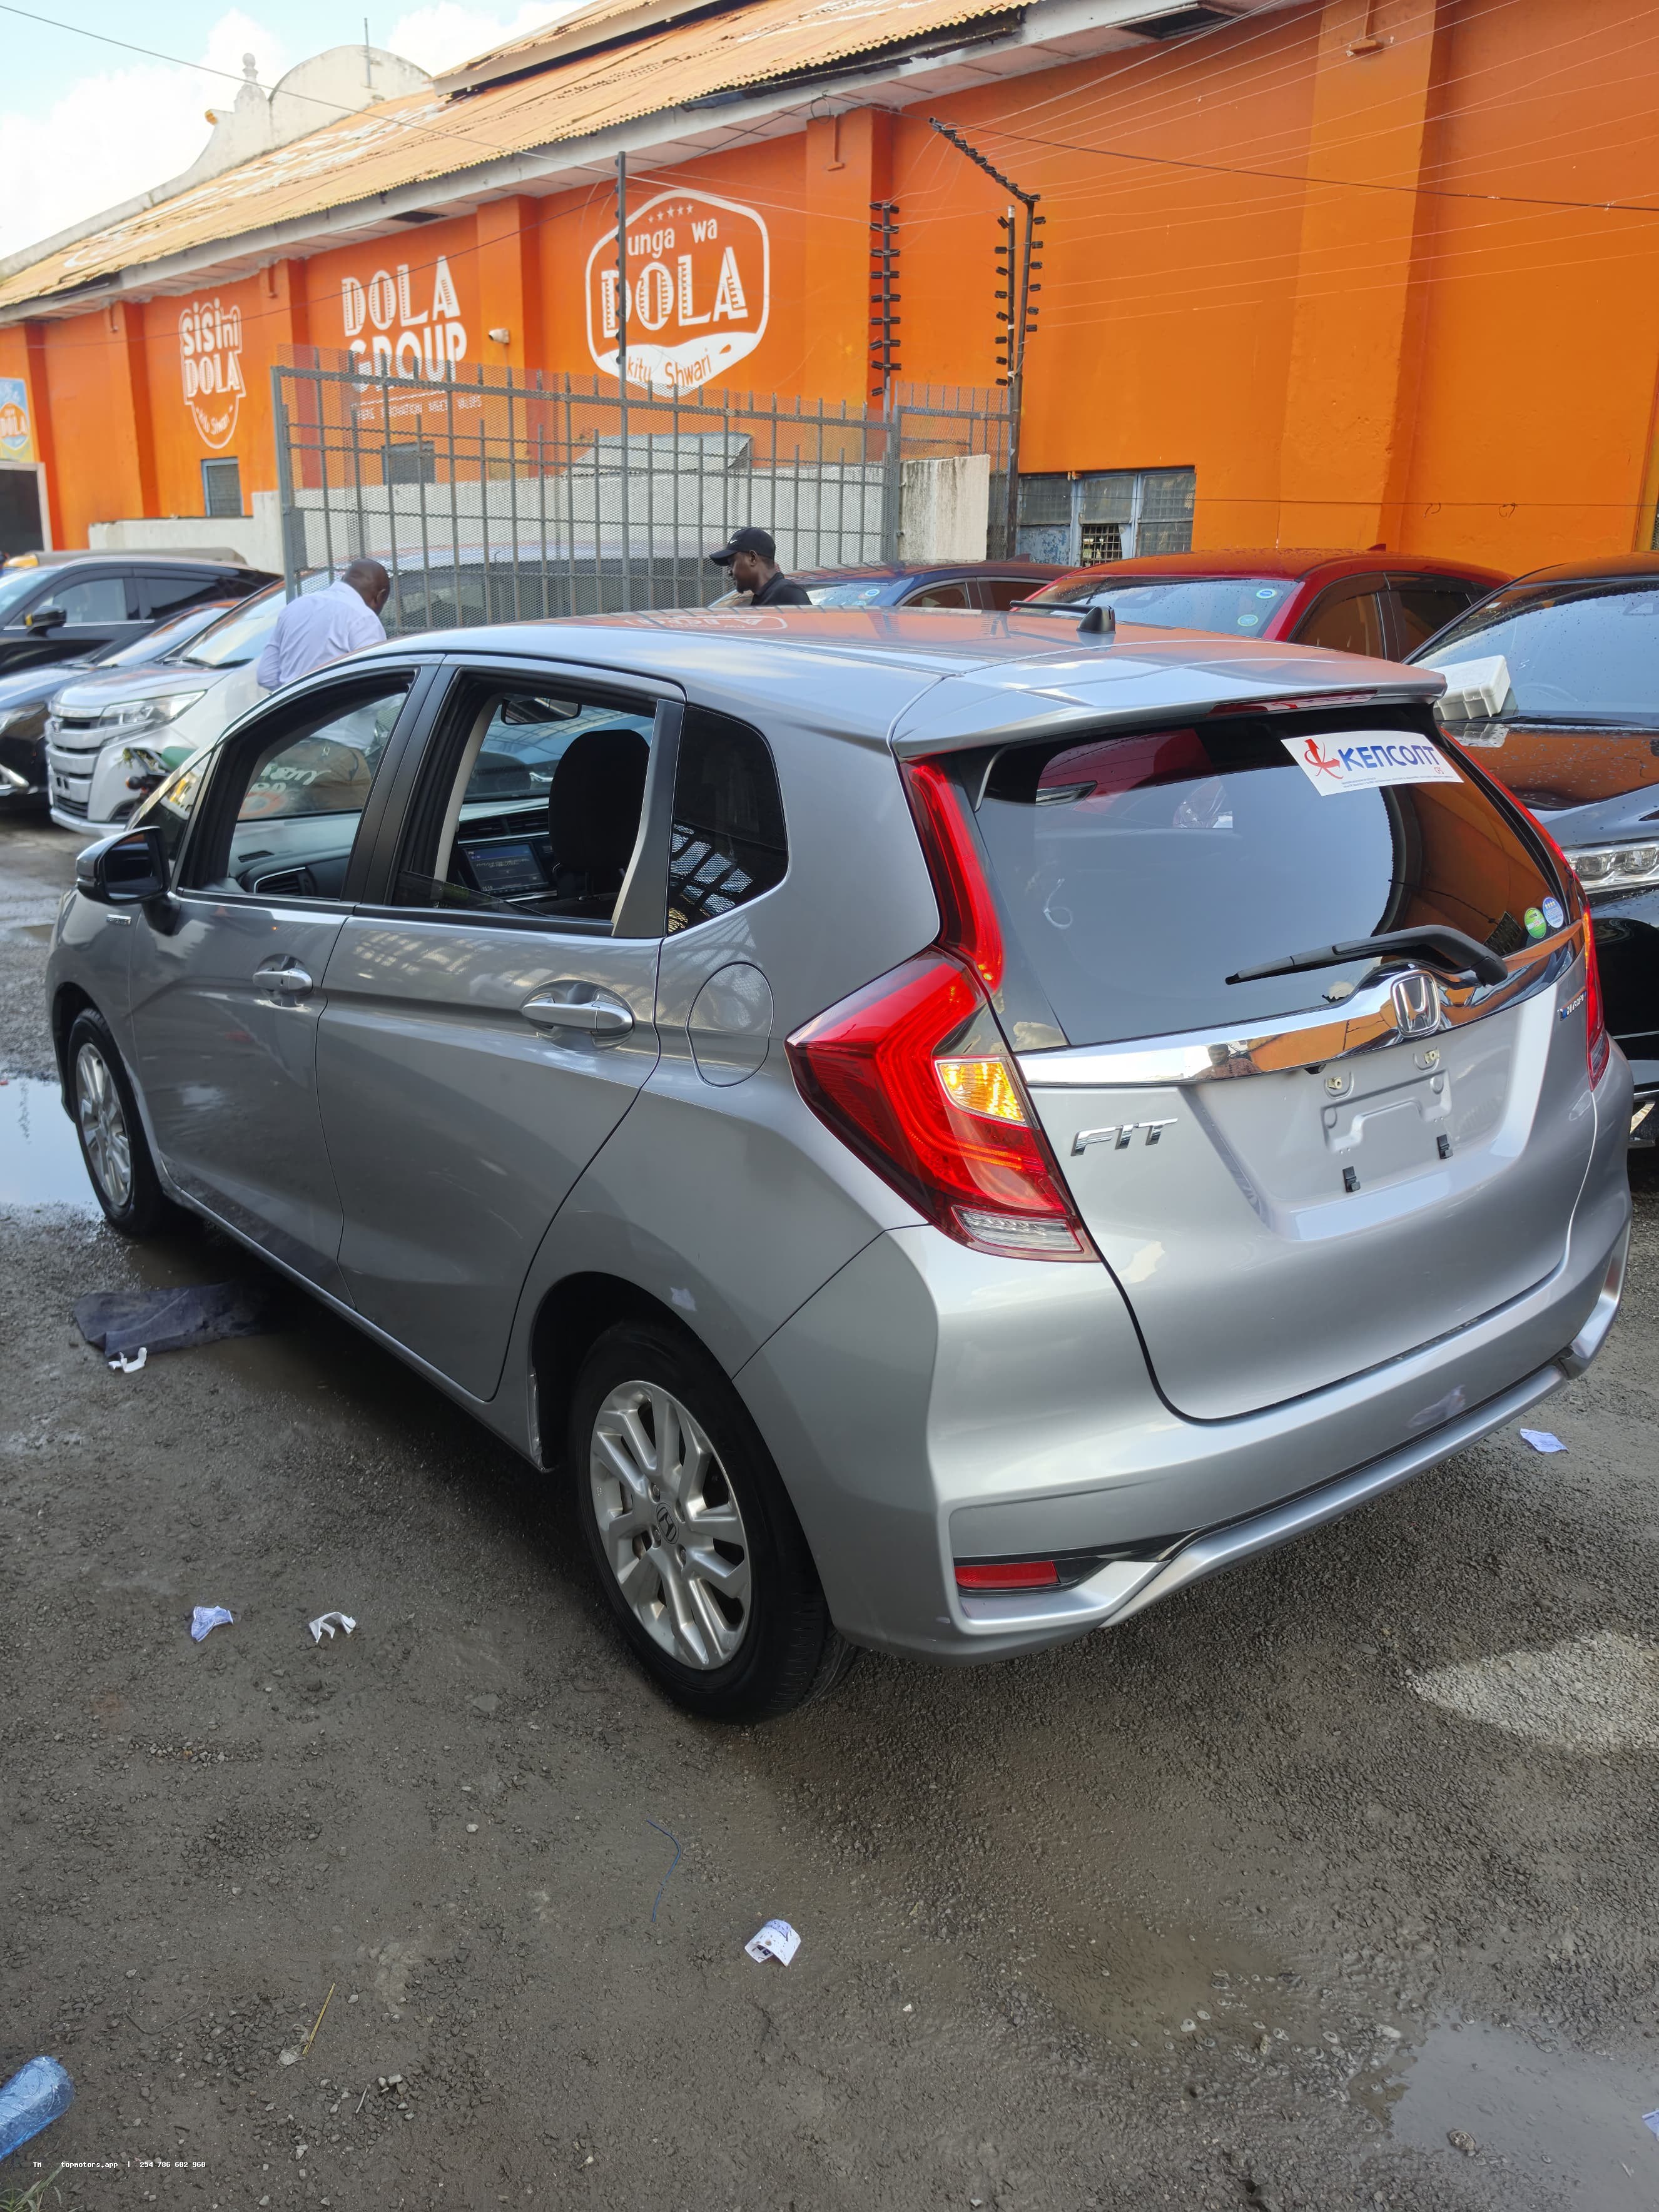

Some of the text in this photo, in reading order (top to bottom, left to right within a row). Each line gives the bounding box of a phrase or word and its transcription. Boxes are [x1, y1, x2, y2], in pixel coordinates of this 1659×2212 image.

[627, 218, 718, 258] unga wa
[342, 255, 462, 337] DOLA
[601, 246, 748, 338] DOLA
[184, 350, 241, 398] DOLA
[348, 321, 467, 393] GROUP
[1070, 1117, 1179, 1157] FIT
